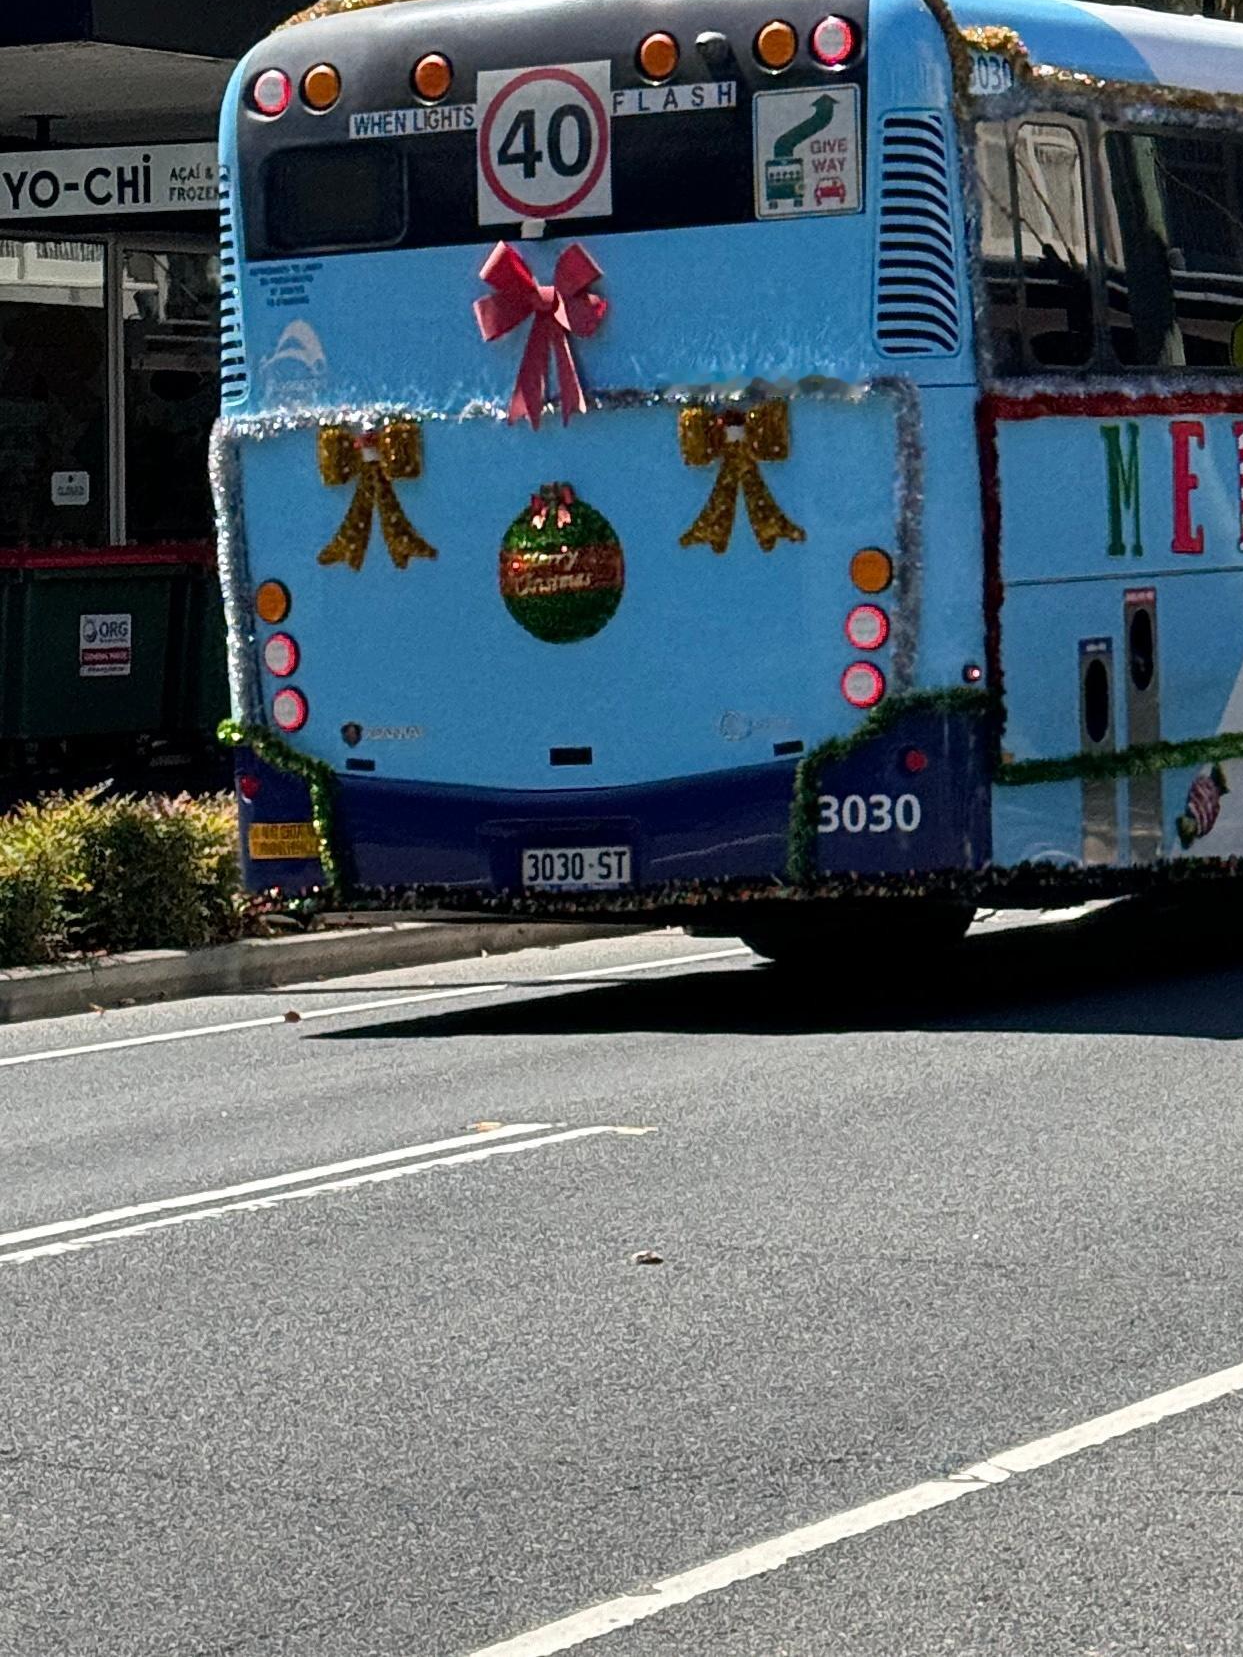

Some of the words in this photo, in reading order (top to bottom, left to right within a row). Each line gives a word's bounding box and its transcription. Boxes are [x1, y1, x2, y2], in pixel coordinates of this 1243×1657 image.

[353, 113, 406, 136] WHEN
[413, 105, 474, 132] LIGHTS
[497, 104, 592, 179] 40
[810, 138, 848, 154] GIVE
[812, 157, 847, 173] WAY
[98, 621, 129, 638] ORG
[817, 794, 921, 833] 3030
